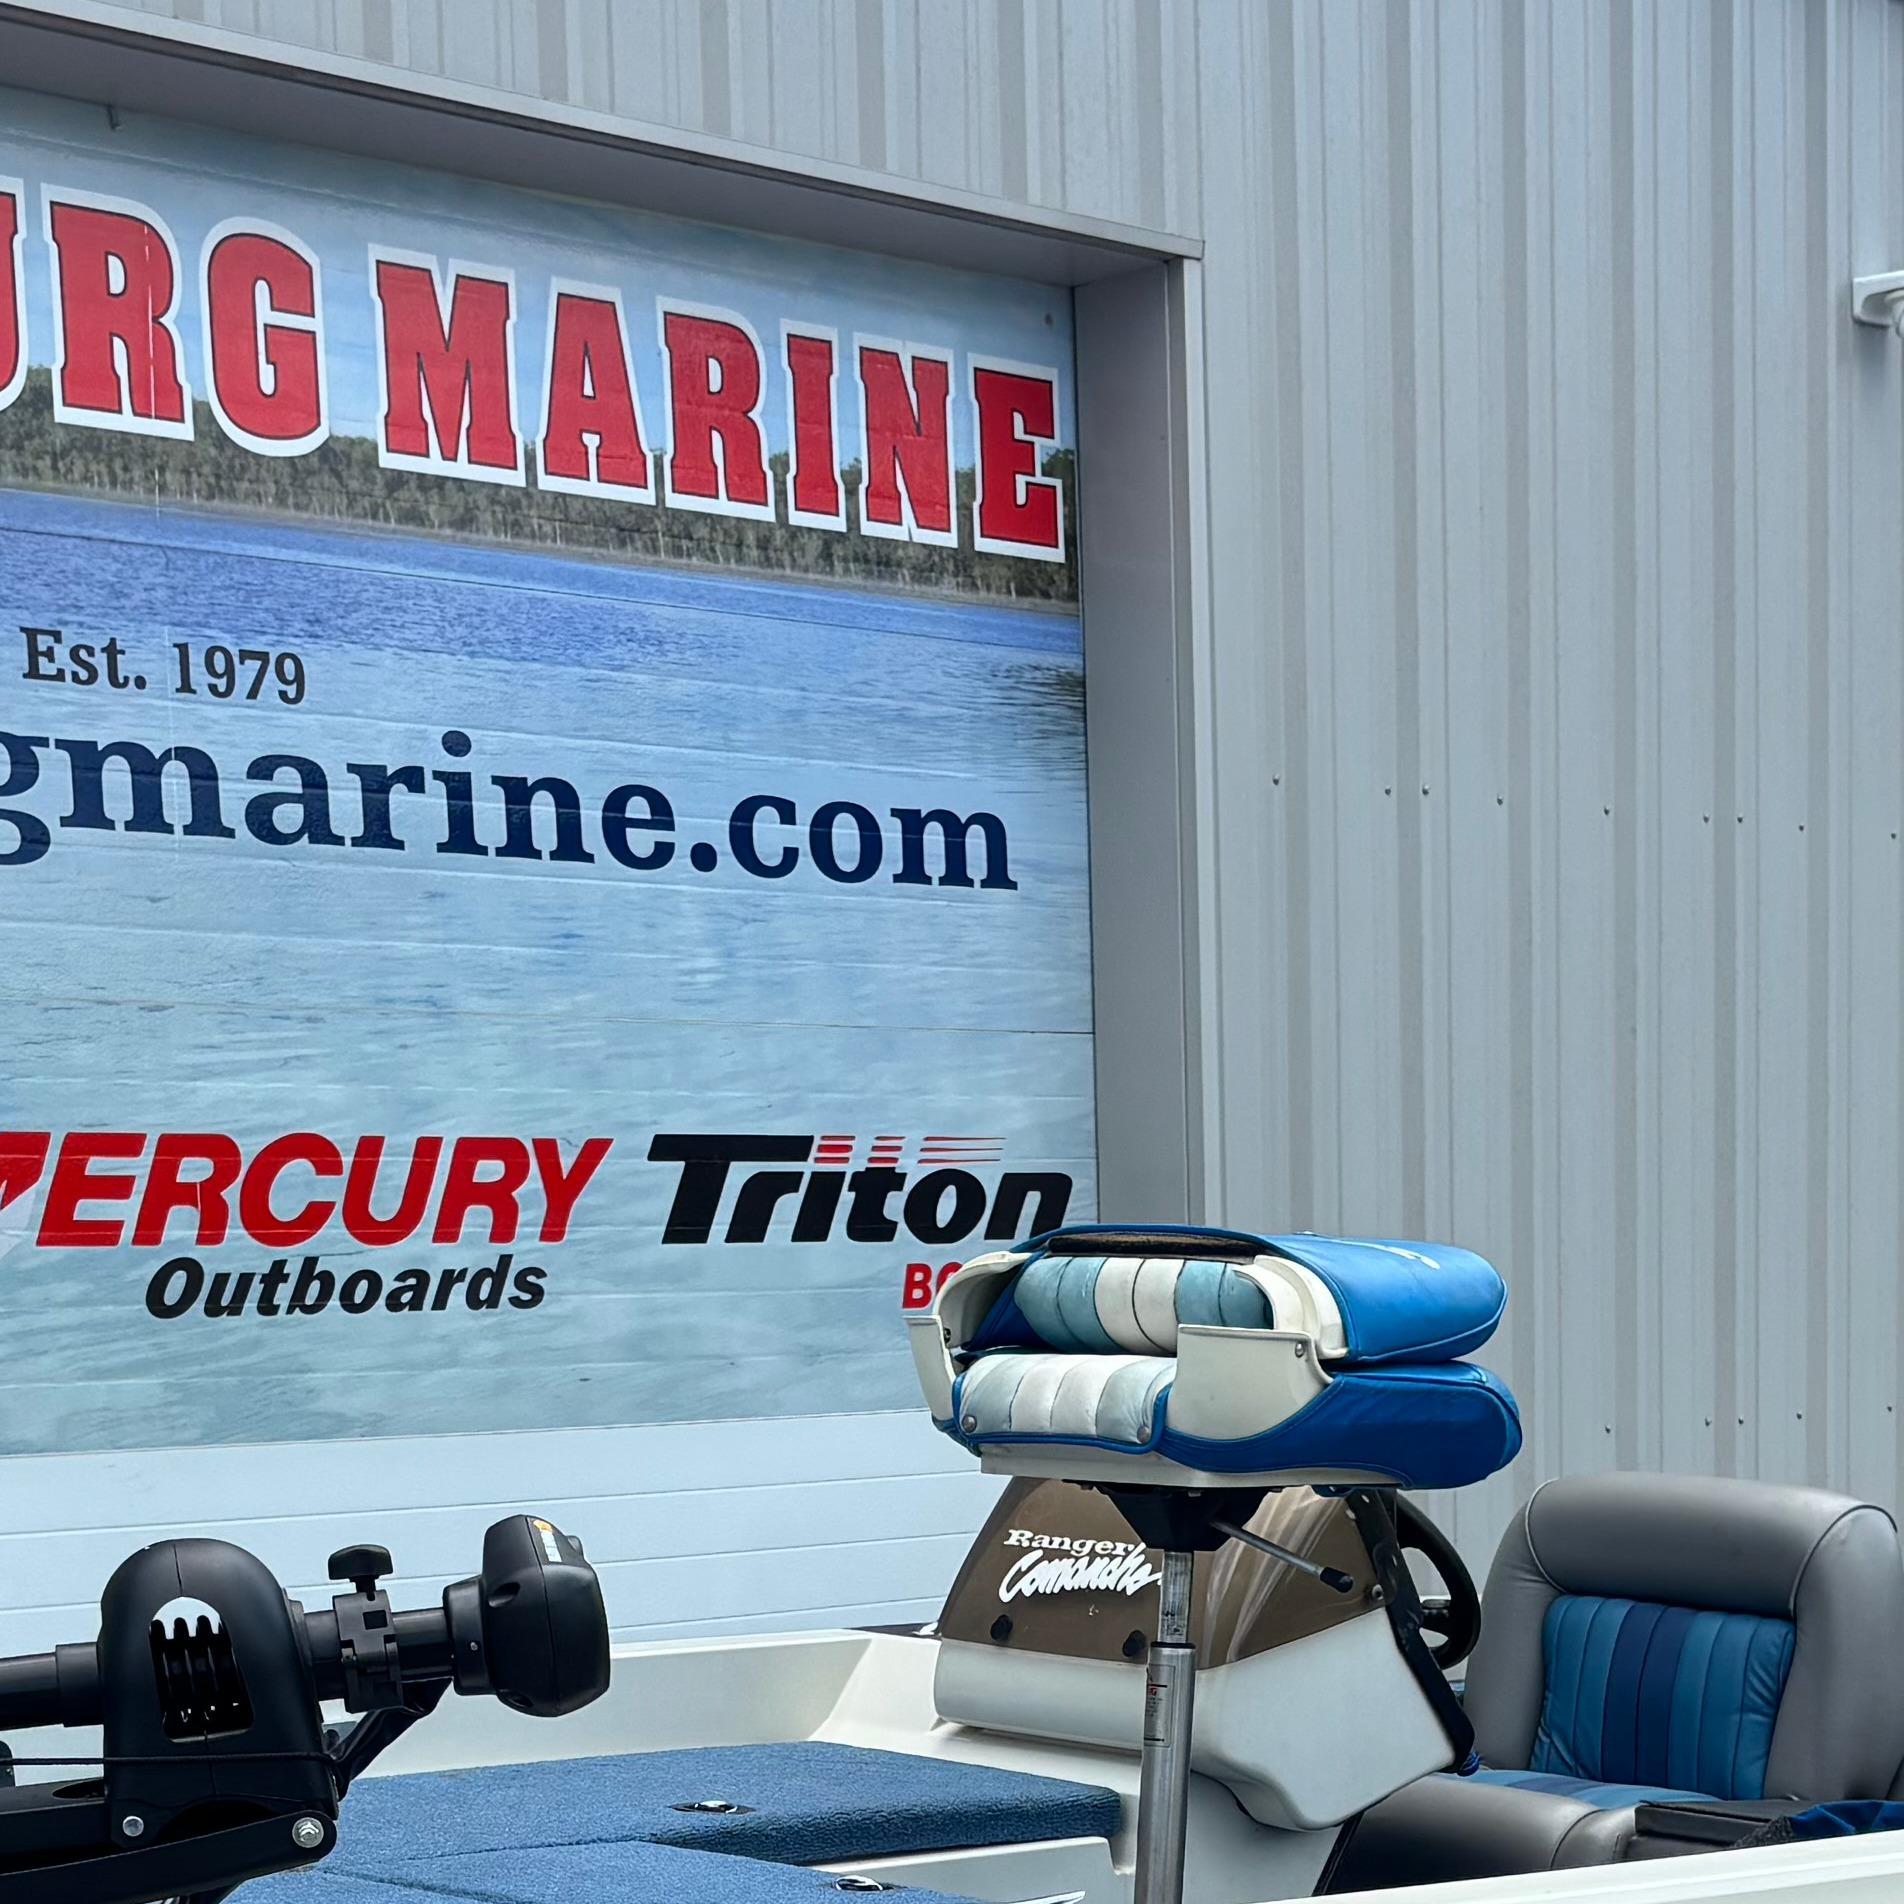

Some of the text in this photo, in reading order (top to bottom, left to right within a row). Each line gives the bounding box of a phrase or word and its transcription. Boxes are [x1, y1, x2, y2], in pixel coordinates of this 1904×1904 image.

[368, 243, 1066, 563] MARINE
[18, 626, 307, 705] Est. 1979
[646, 1133, 1074, 1244] Triton
[143, 1252, 548, 1321] Outboards
[1003, 1529, 1138, 1556] Ranger
